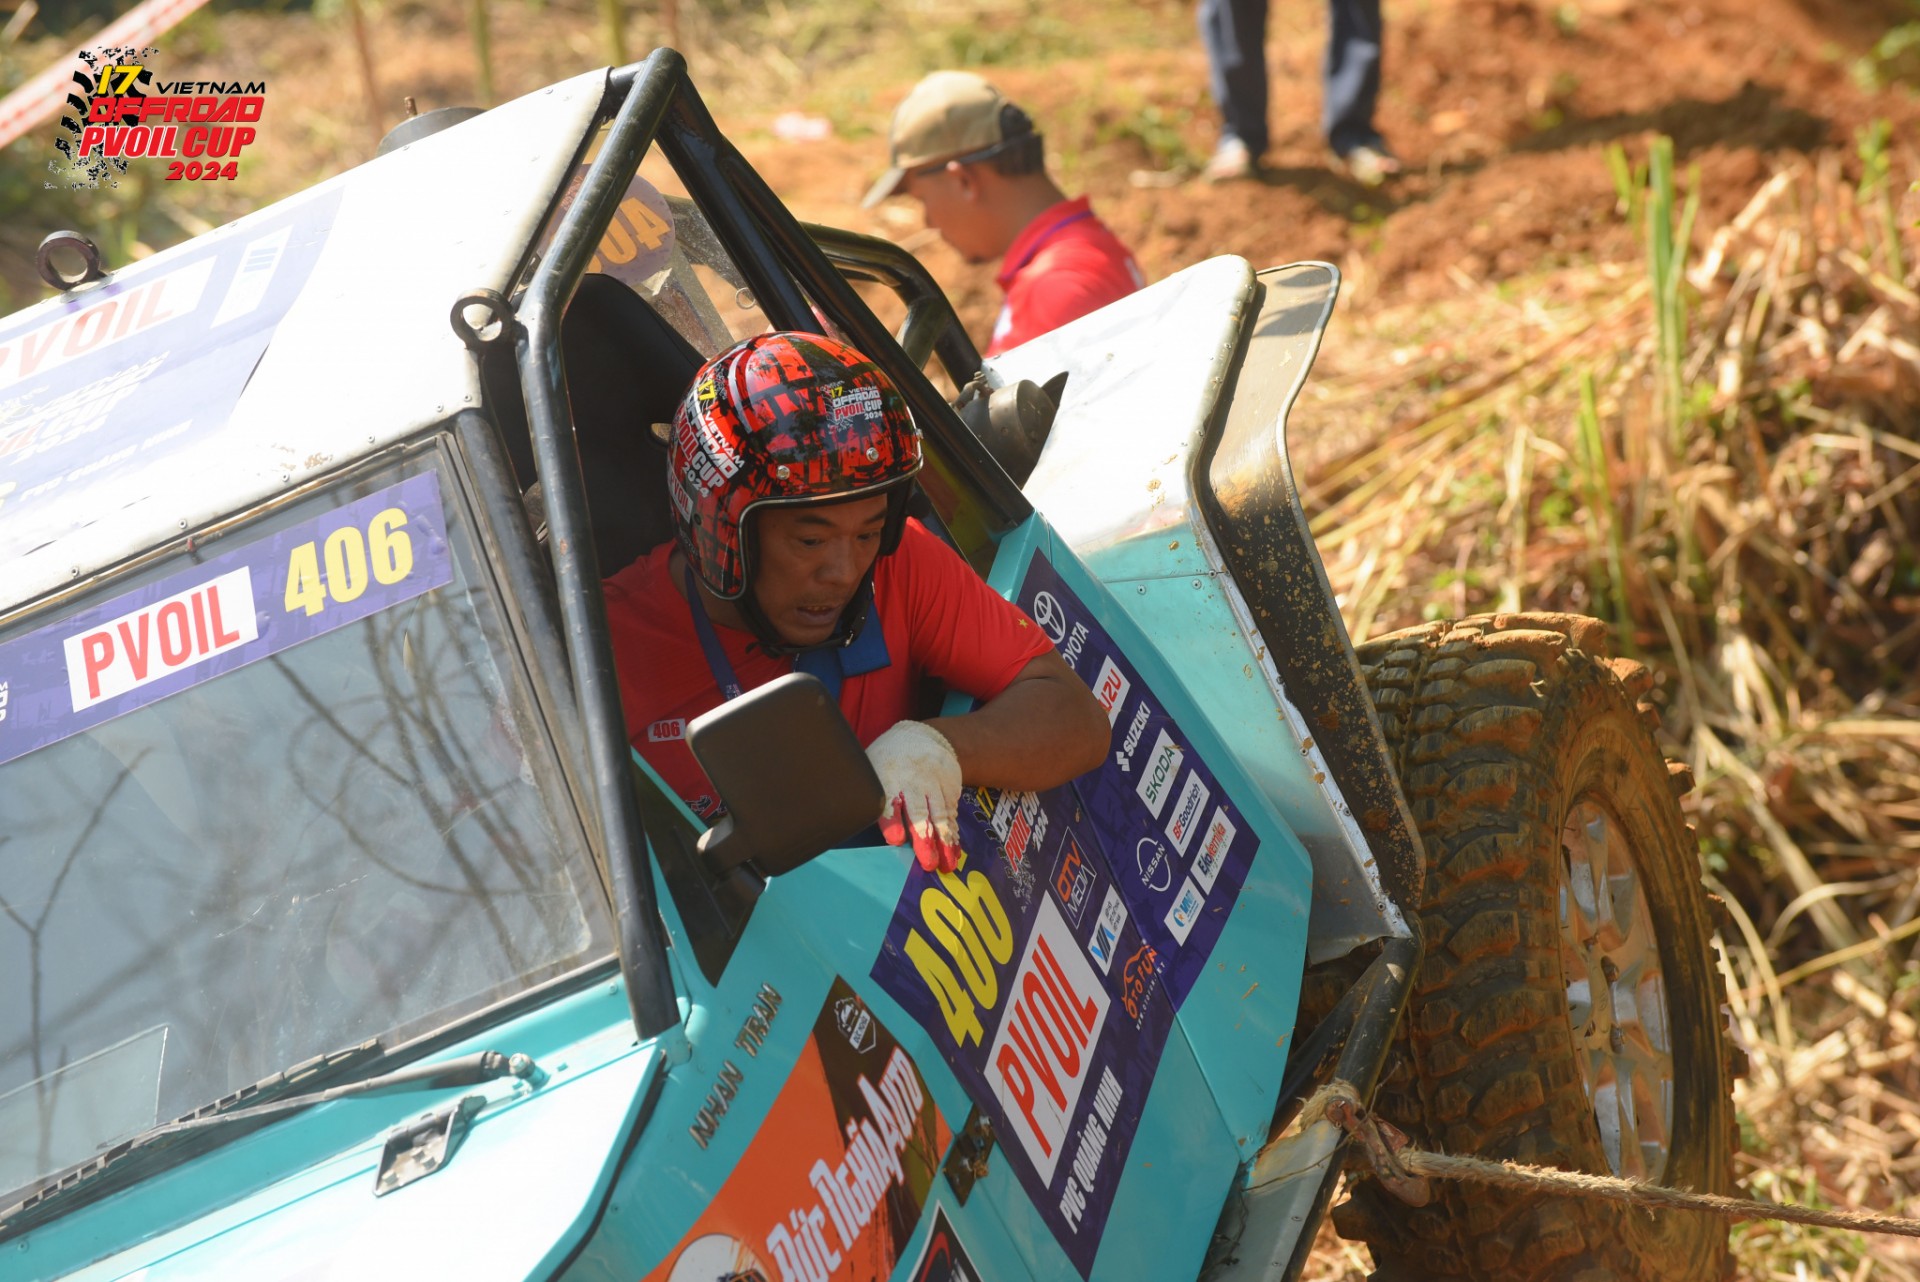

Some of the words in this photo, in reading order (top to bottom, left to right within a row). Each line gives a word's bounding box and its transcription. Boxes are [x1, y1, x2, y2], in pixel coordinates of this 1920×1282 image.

[698, 379, 716, 400] 17
[830, 385, 843, 399] 17
[848, 385, 878, 394] VIETNAM
[832, 389, 881, 408] OFFROAD
[833, 401, 866, 422] PVOIL
[864, 399, 883, 412] CUP
[705, 410, 745, 468] VIETNAM
[864, 410, 883, 420] 2024
[682, 461, 710, 498] 2024
[692, 451, 725, 488] CUP
[81, 585, 240, 700] PVOIL
[284, 507, 414, 617] 406
[1062, 621, 1090, 671] OYOTA
[653, 721, 681, 739] 406
[1123, 700, 1152, 757] SUZUKI
[1032, 808, 1049, 852] 2024
[1173, 783, 1200, 840] BFGoodrich
[1004, 805, 1032, 875] PVOIL
[1141, 843, 1165, 886] NISSAN
[1056, 842, 1089, 901] OTV
[904, 852, 1014, 1048] 406
[688, 1060, 744, 1150] NHAN
[735, 982, 783, 1057] TRAN
[996, 934, 1098, 1159] PVOIL
[1059, 1194, 1087, 1235] PVC
[1074, 1129, 1105, 1193] QUẢNG
[1095, 1065, 1123, 1138] NINH
